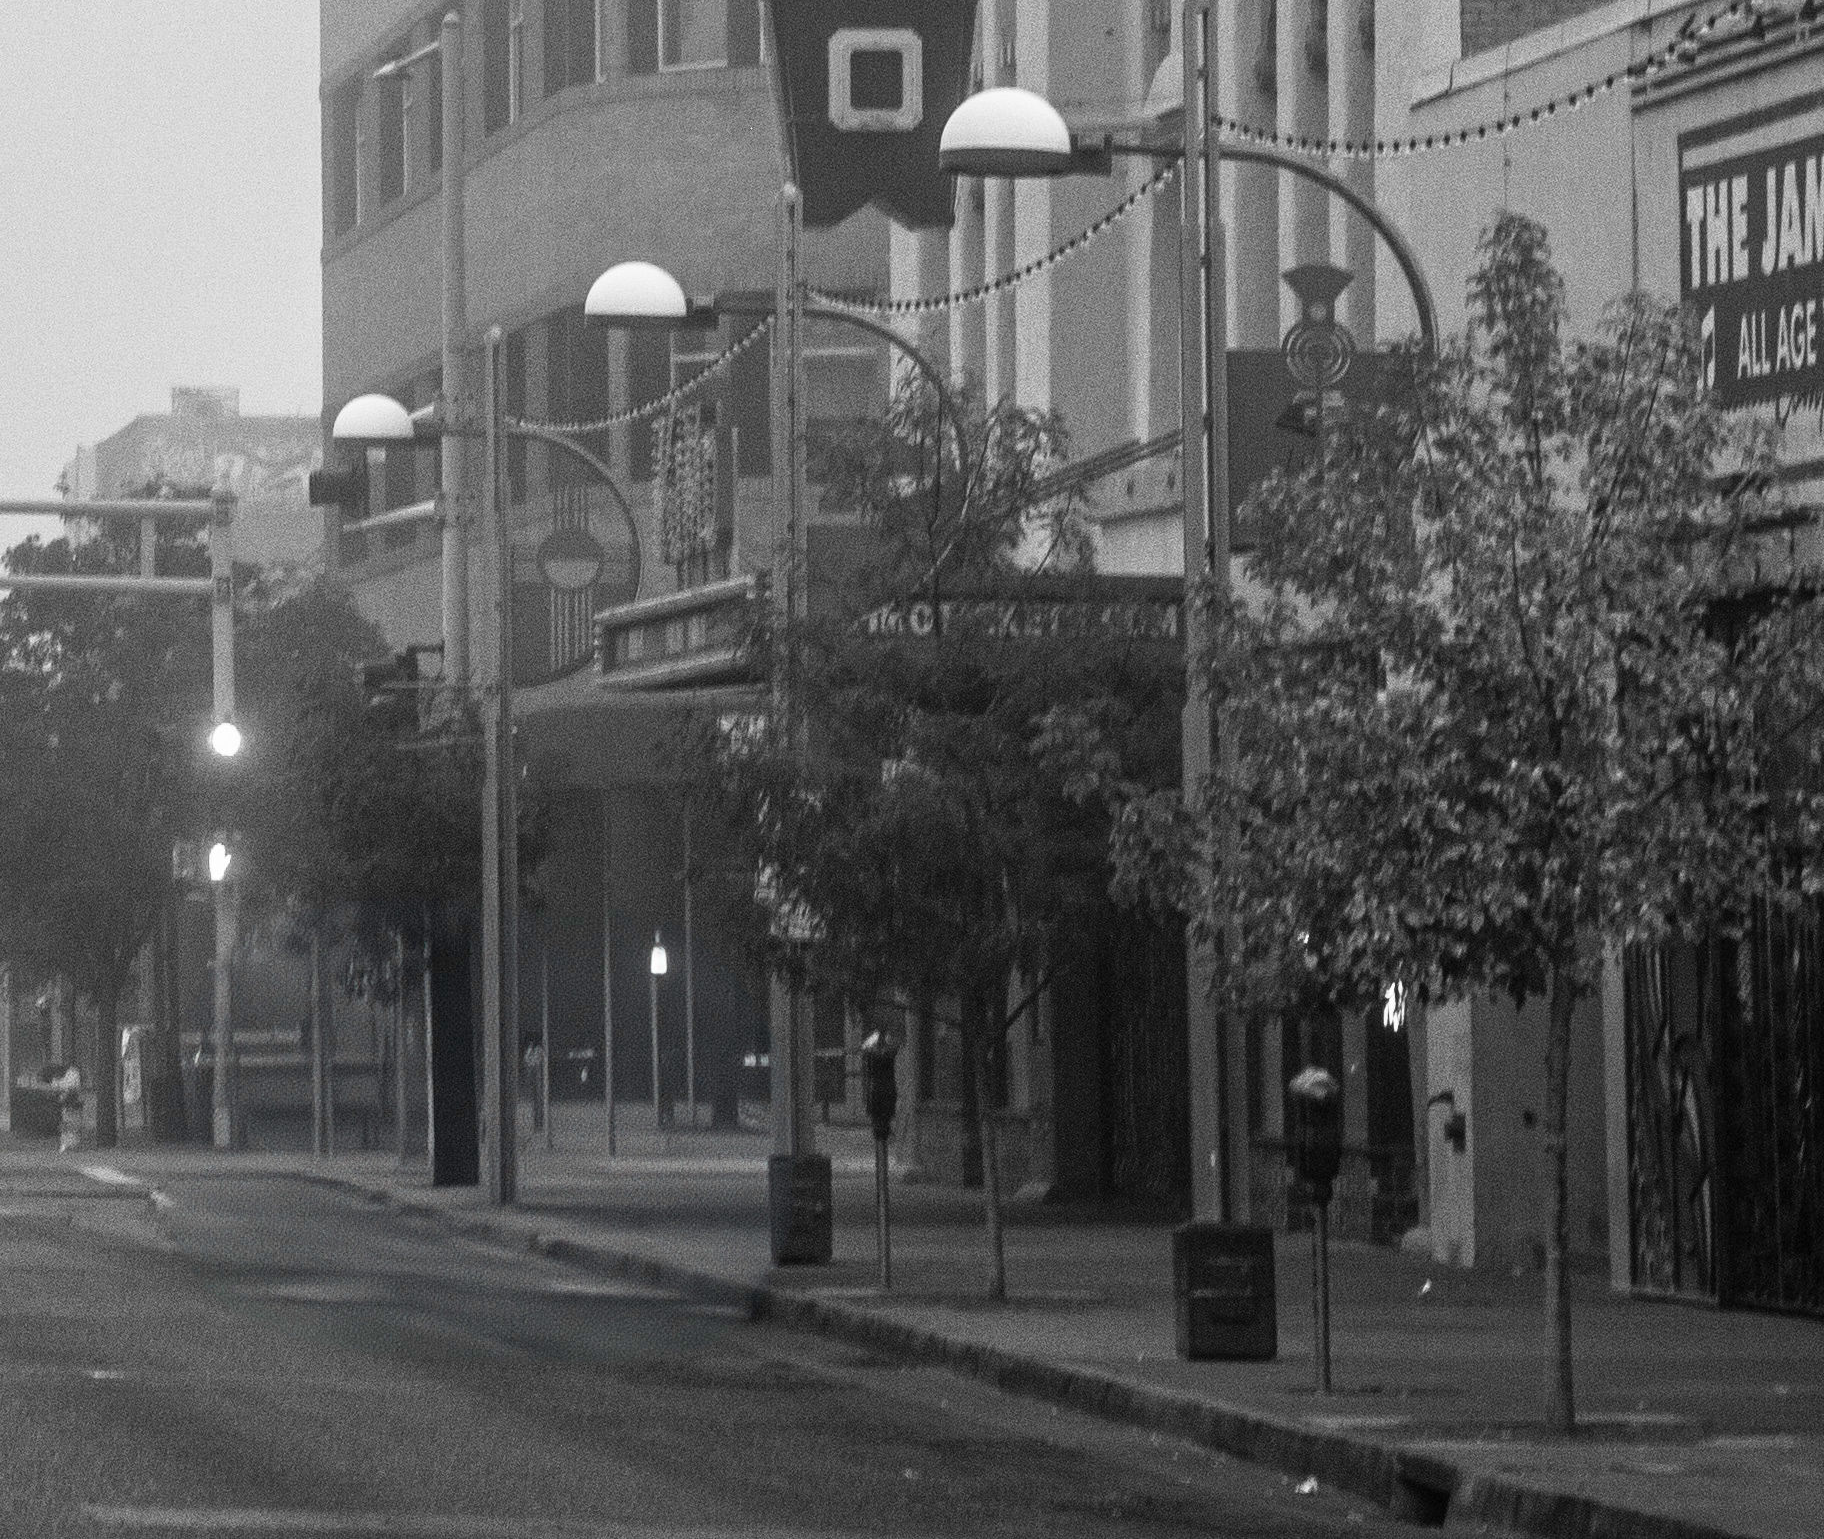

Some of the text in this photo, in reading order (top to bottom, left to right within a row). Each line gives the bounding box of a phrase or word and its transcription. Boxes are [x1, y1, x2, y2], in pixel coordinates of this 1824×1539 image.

[1686, 173, 1749, 290] THE
[1737, 297, 1824, 379] ALL AGE
